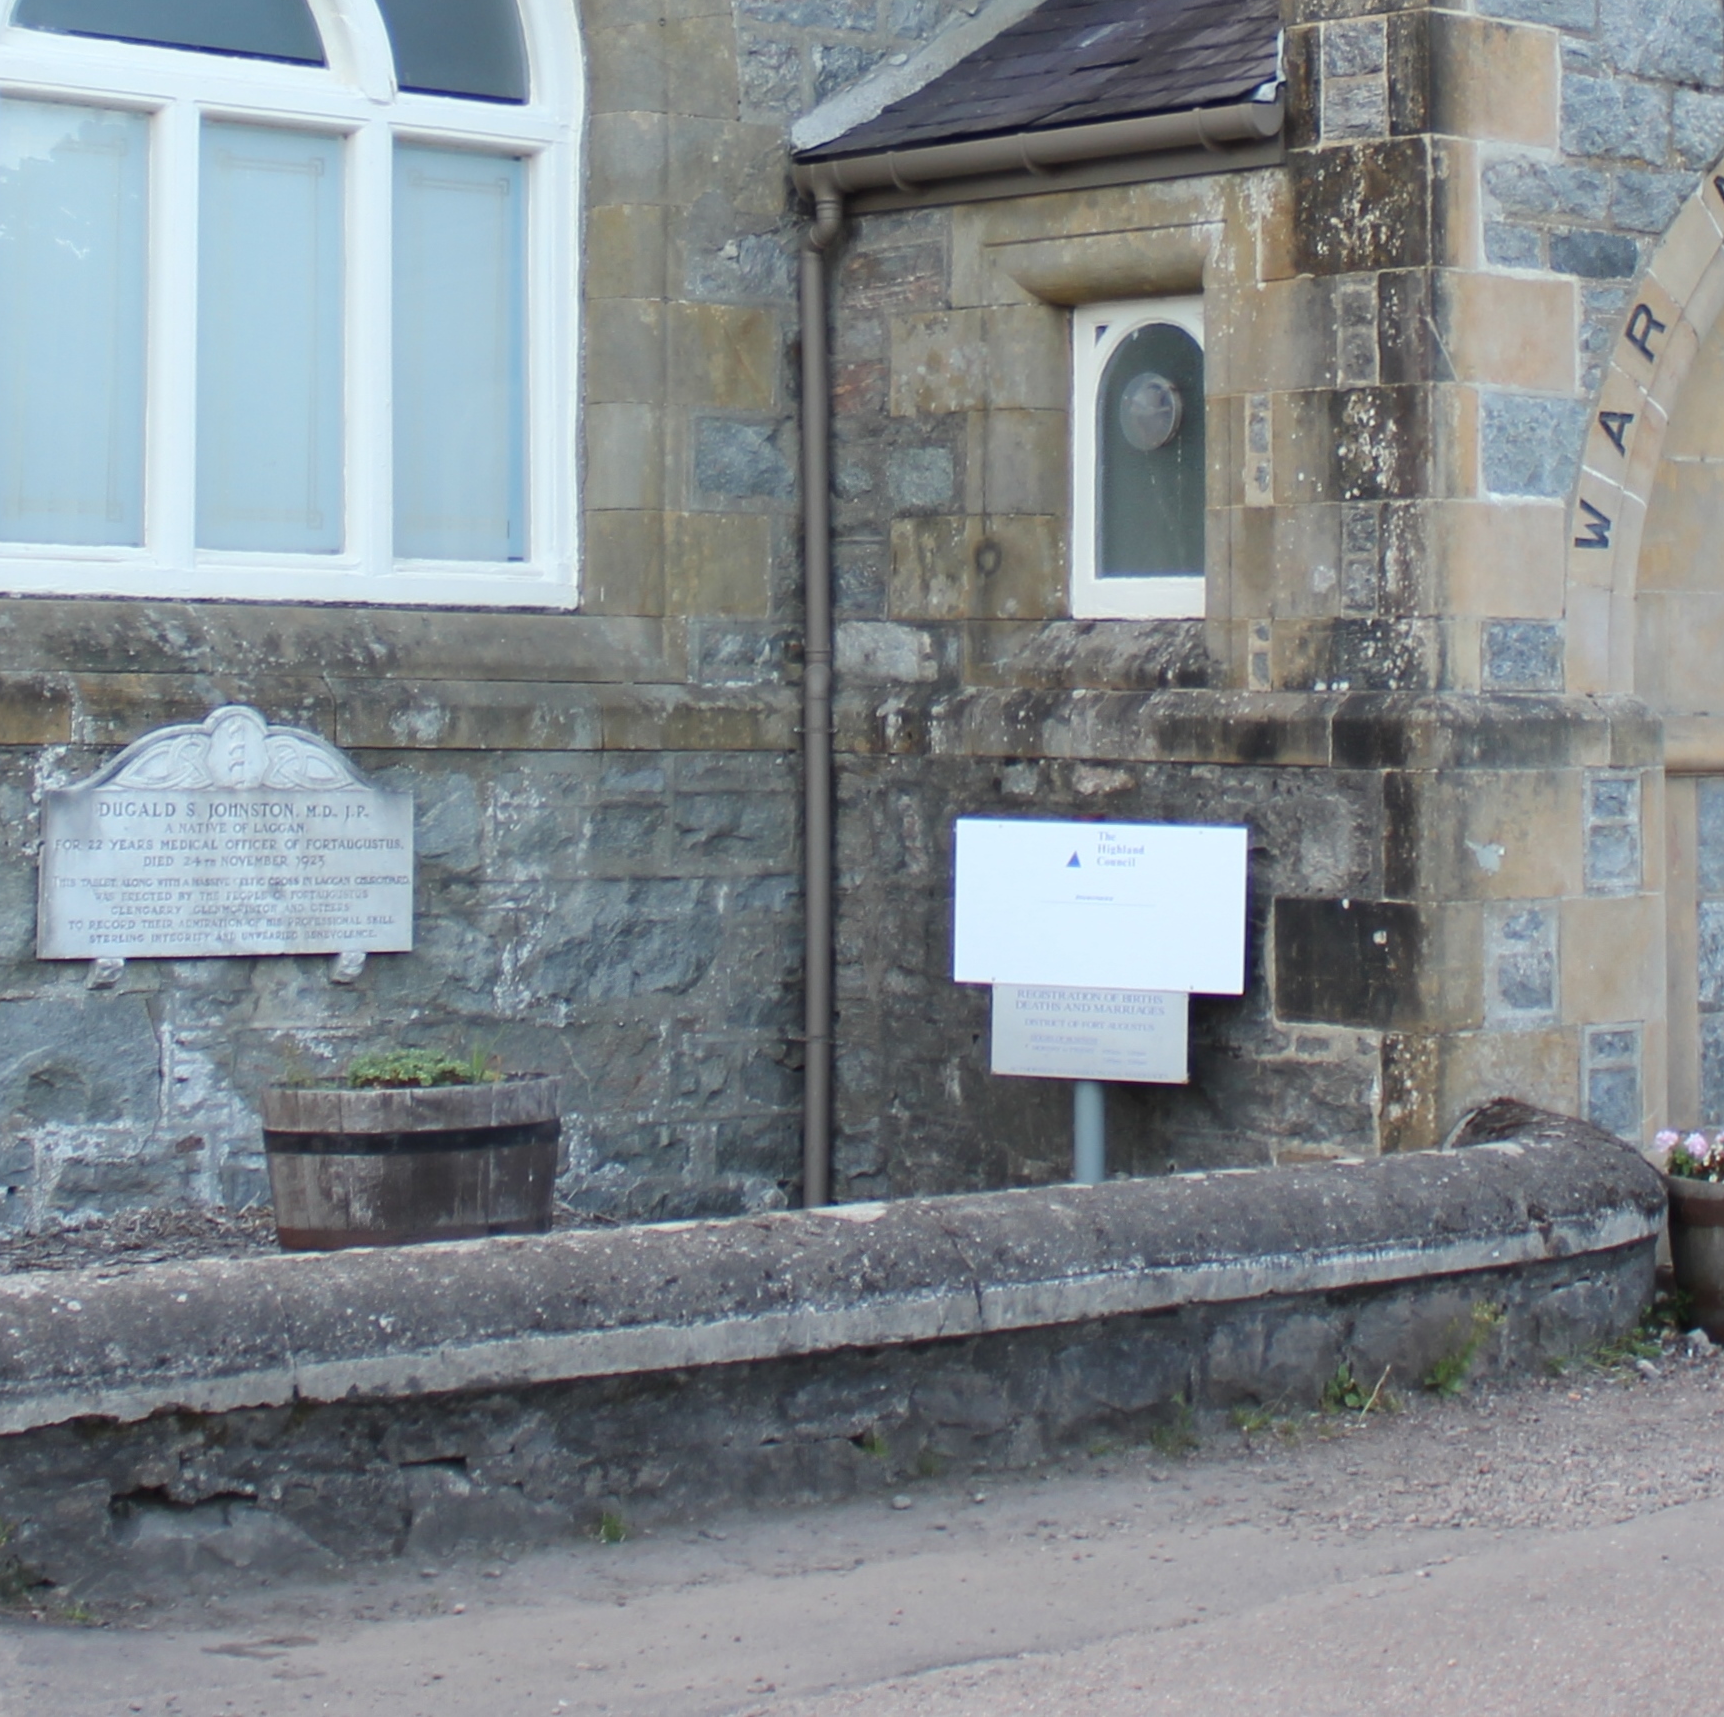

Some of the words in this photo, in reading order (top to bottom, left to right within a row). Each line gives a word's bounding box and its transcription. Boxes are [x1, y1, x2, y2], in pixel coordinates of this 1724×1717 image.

[1574, 301, 1666, 551] WAR
[99, 802, 176, 818] DUGALD
[165, 823, 174, 834] A
[179, 823, 226, 834] NATIVE
[233, 823, 249, 834] OF
[1098, 831, 1116, 842] The
[54, 839, 81, 851] FOR
[88, 839, 103, 851] 22
[110, 839, 153, 851] YEARS
[161, 839, 218, 851] MEDICAL
[225, 838, 276, 850] OFFICER
[285, 839, 299, 850] OF
[1097, 844, 1145, 856] Highland
[143, 856, 174, 868] DIED
[220, 855, 288, 867] NOVEMBER
[1096, 856, 1136, 867] Council
[121, 891, 176, 902] ERECTED
[178, 891, 192, 901] BY
[68, 919, 83, 930] TO
[88, 919, 136, 930] RECORD
[142, 919, 173, 930] THEIR
[288, 916, 361, 927] PROFESSIONAL
[89, 934, 145, 944] STERLING
[150, 933, 210, 944] INTEGRITY
[1017, 989, 1102, 1002] REGISTRATION
[1104, 993, 1117, 1003] OF
[1122, 994, 1163, 1005] BIRTHS
[1016, 1000, 1061, 1011] DEATHS
[1063, 1002, 1091, 1013] AND
[1093, 1004, 1166, 1016] MARRIAGES
